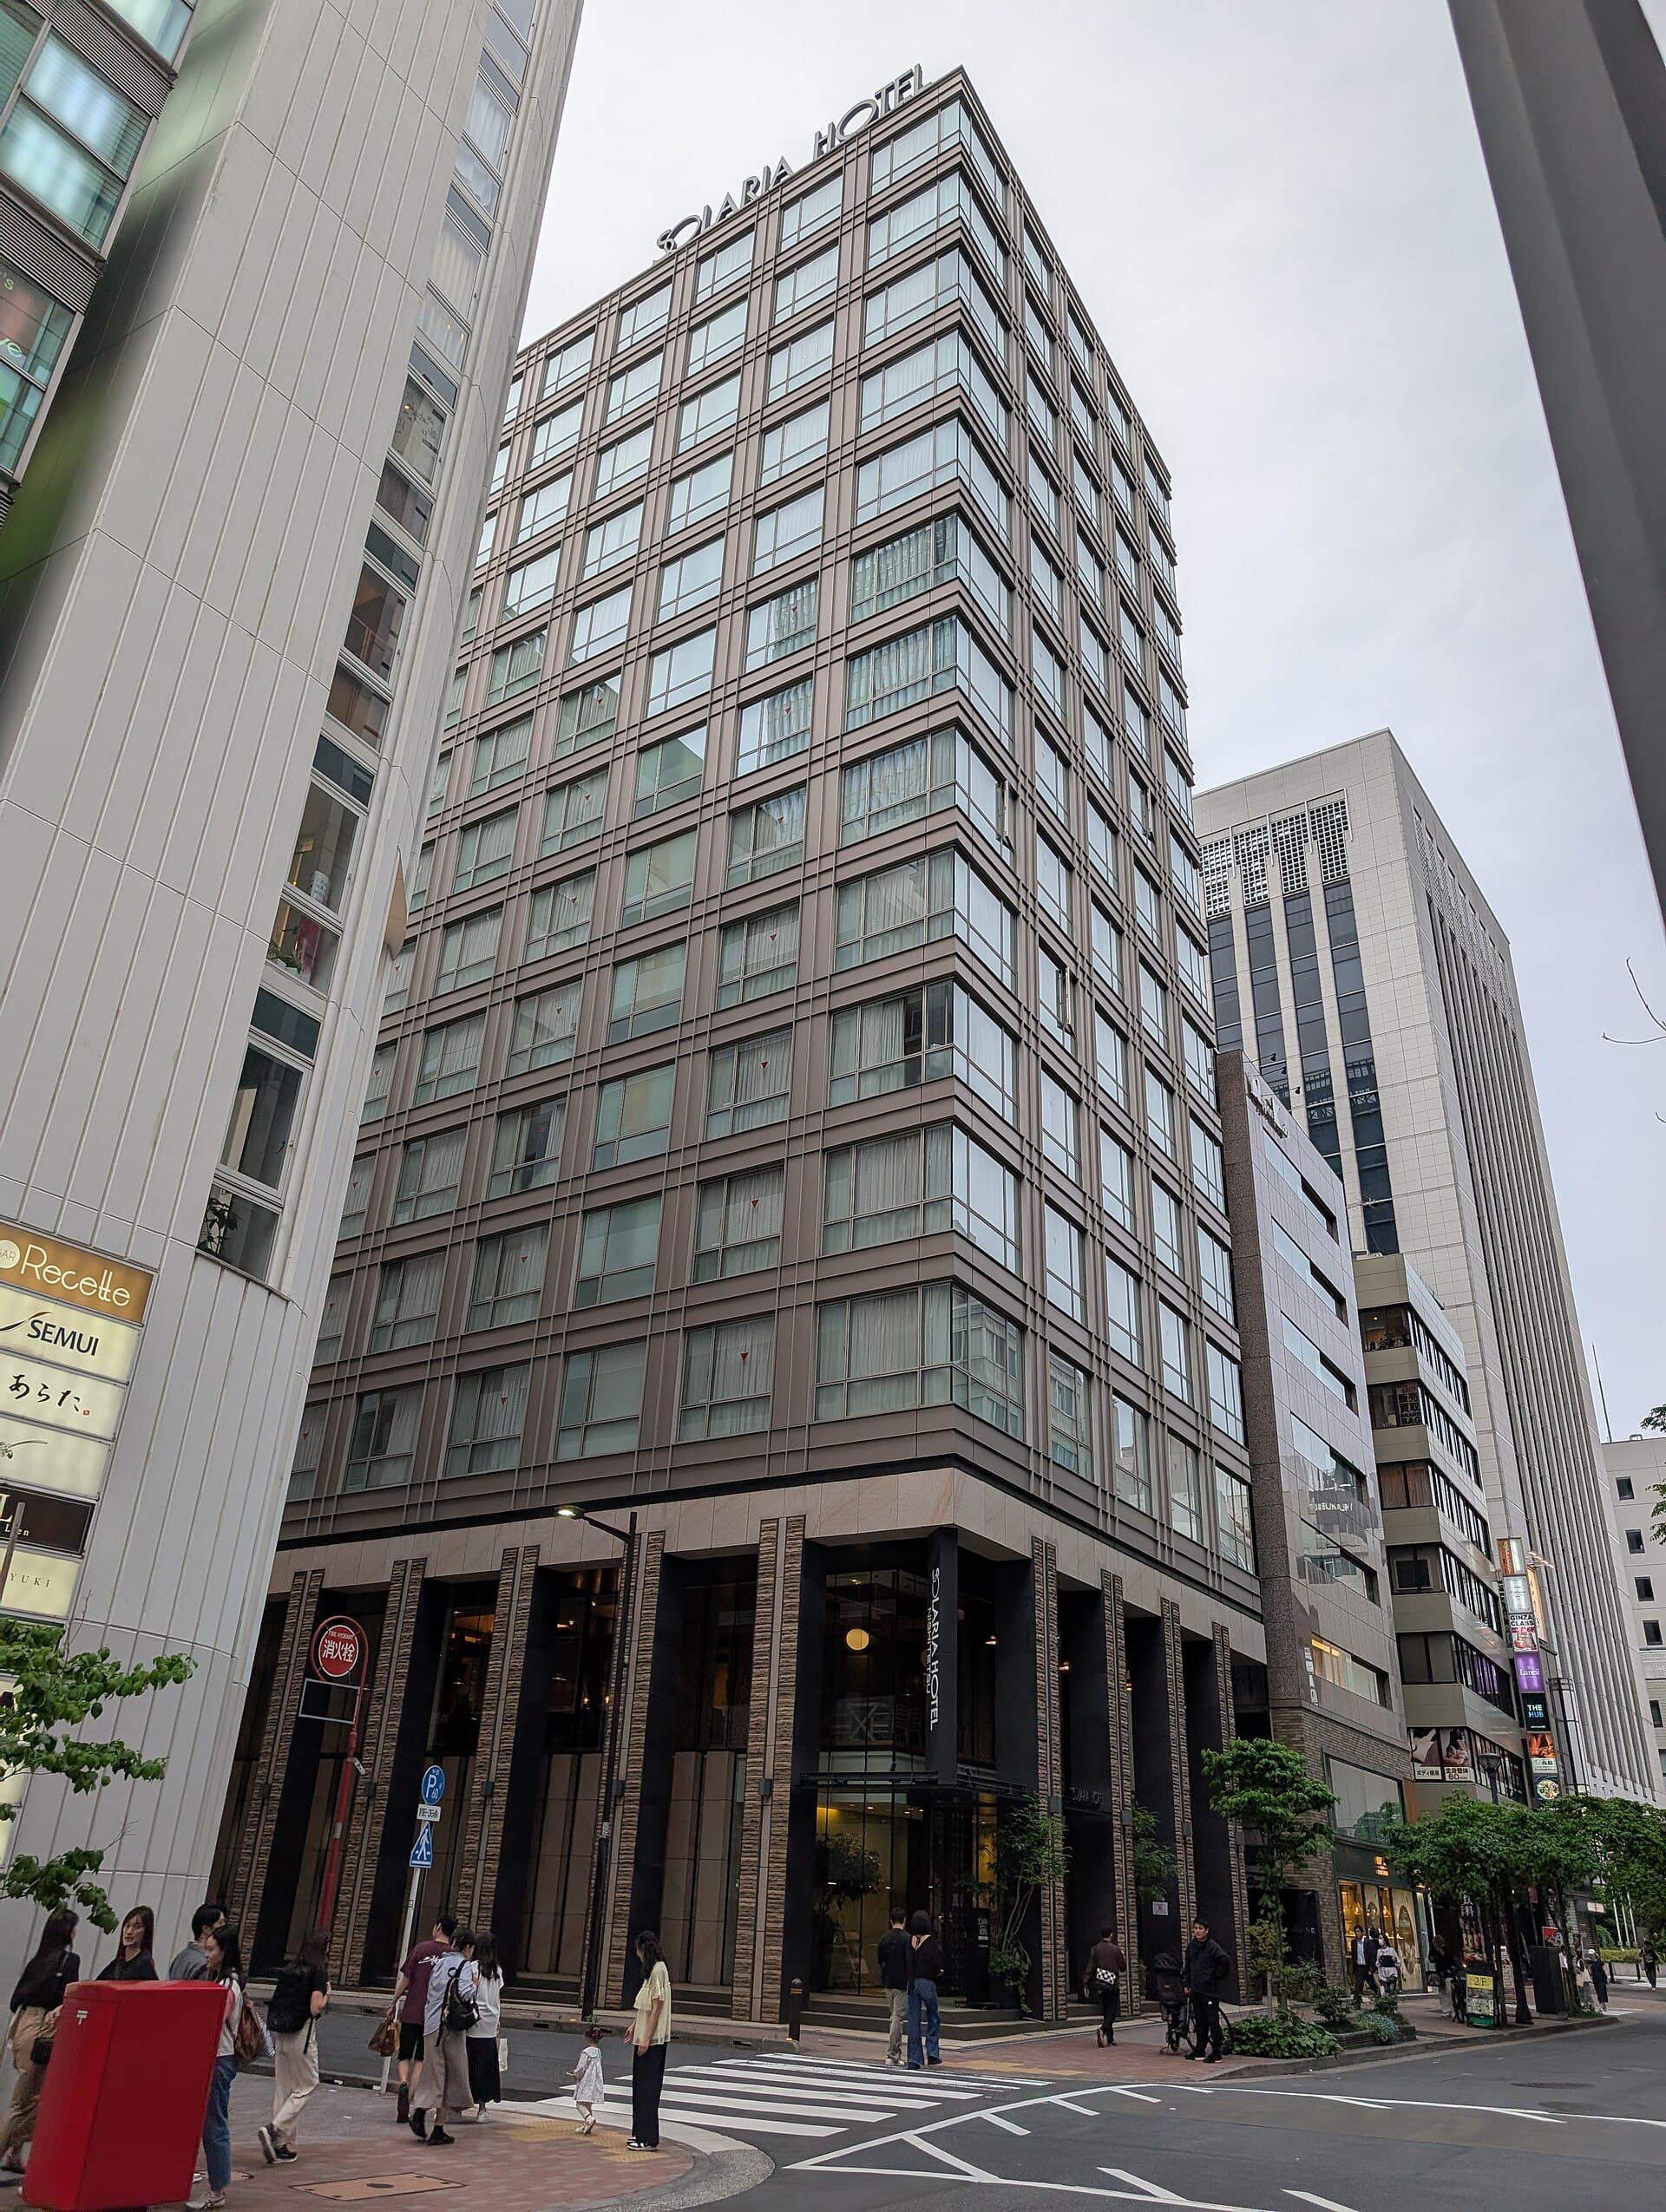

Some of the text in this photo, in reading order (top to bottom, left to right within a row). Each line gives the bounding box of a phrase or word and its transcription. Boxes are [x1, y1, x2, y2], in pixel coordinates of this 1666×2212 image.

[656, 63, 934, 254] SOLARIA HOTEL
[20, 1243, 131, 1306] Recette
[27, 1319, 100, 1356] SEMUI
[9, 1374, 81, 1412] あらた
[1401, 1417, 1422, 1425] BAG
[4, 1523, 30, 1536] Len
[10, 1572, 51, 1588] YUKI
[322, 1639, 356, 1663] 消火栓
[930, 1567, 940, 1731] SOLARIA HOTEL
[425, 1774, 436, 1798] P
